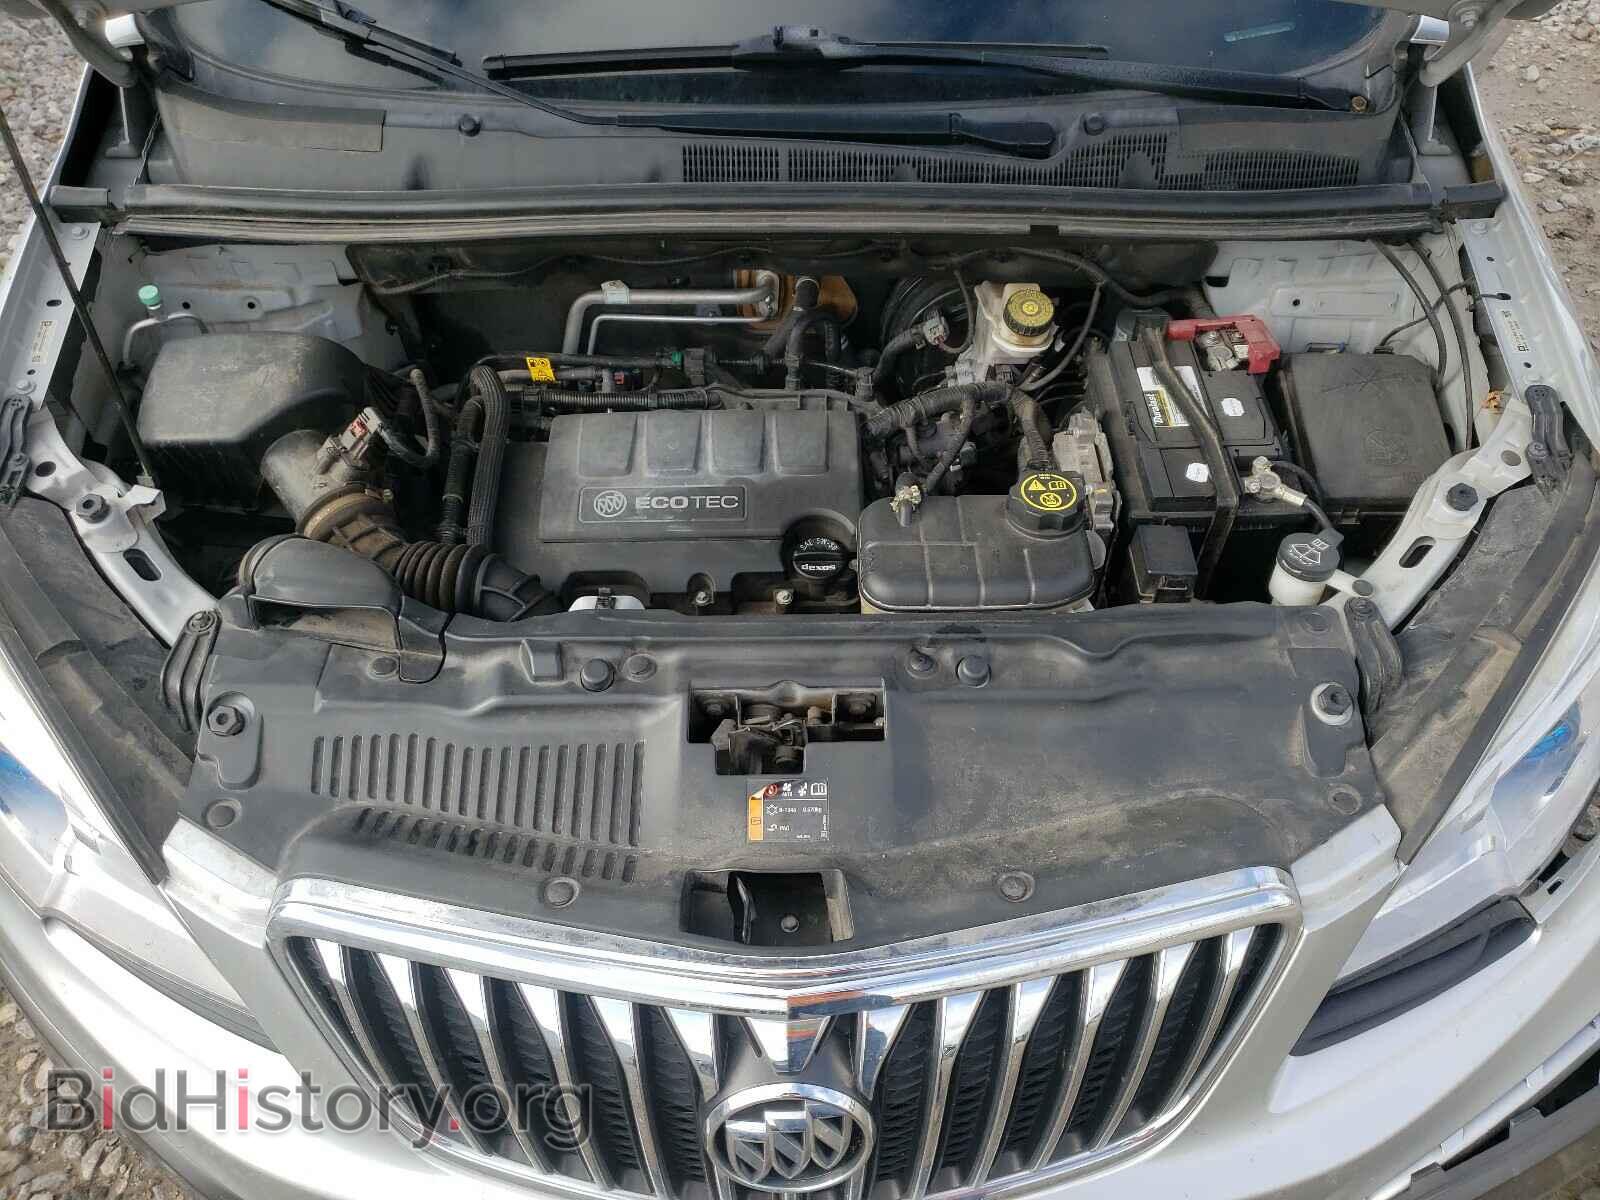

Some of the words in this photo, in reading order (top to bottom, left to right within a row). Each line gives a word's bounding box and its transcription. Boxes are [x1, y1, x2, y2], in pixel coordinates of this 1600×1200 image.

[1146, 393, 1164, 424] Duralast
[635, 495, 739, 509] ECOTEC
[800, 563, 836, 571] dexos
